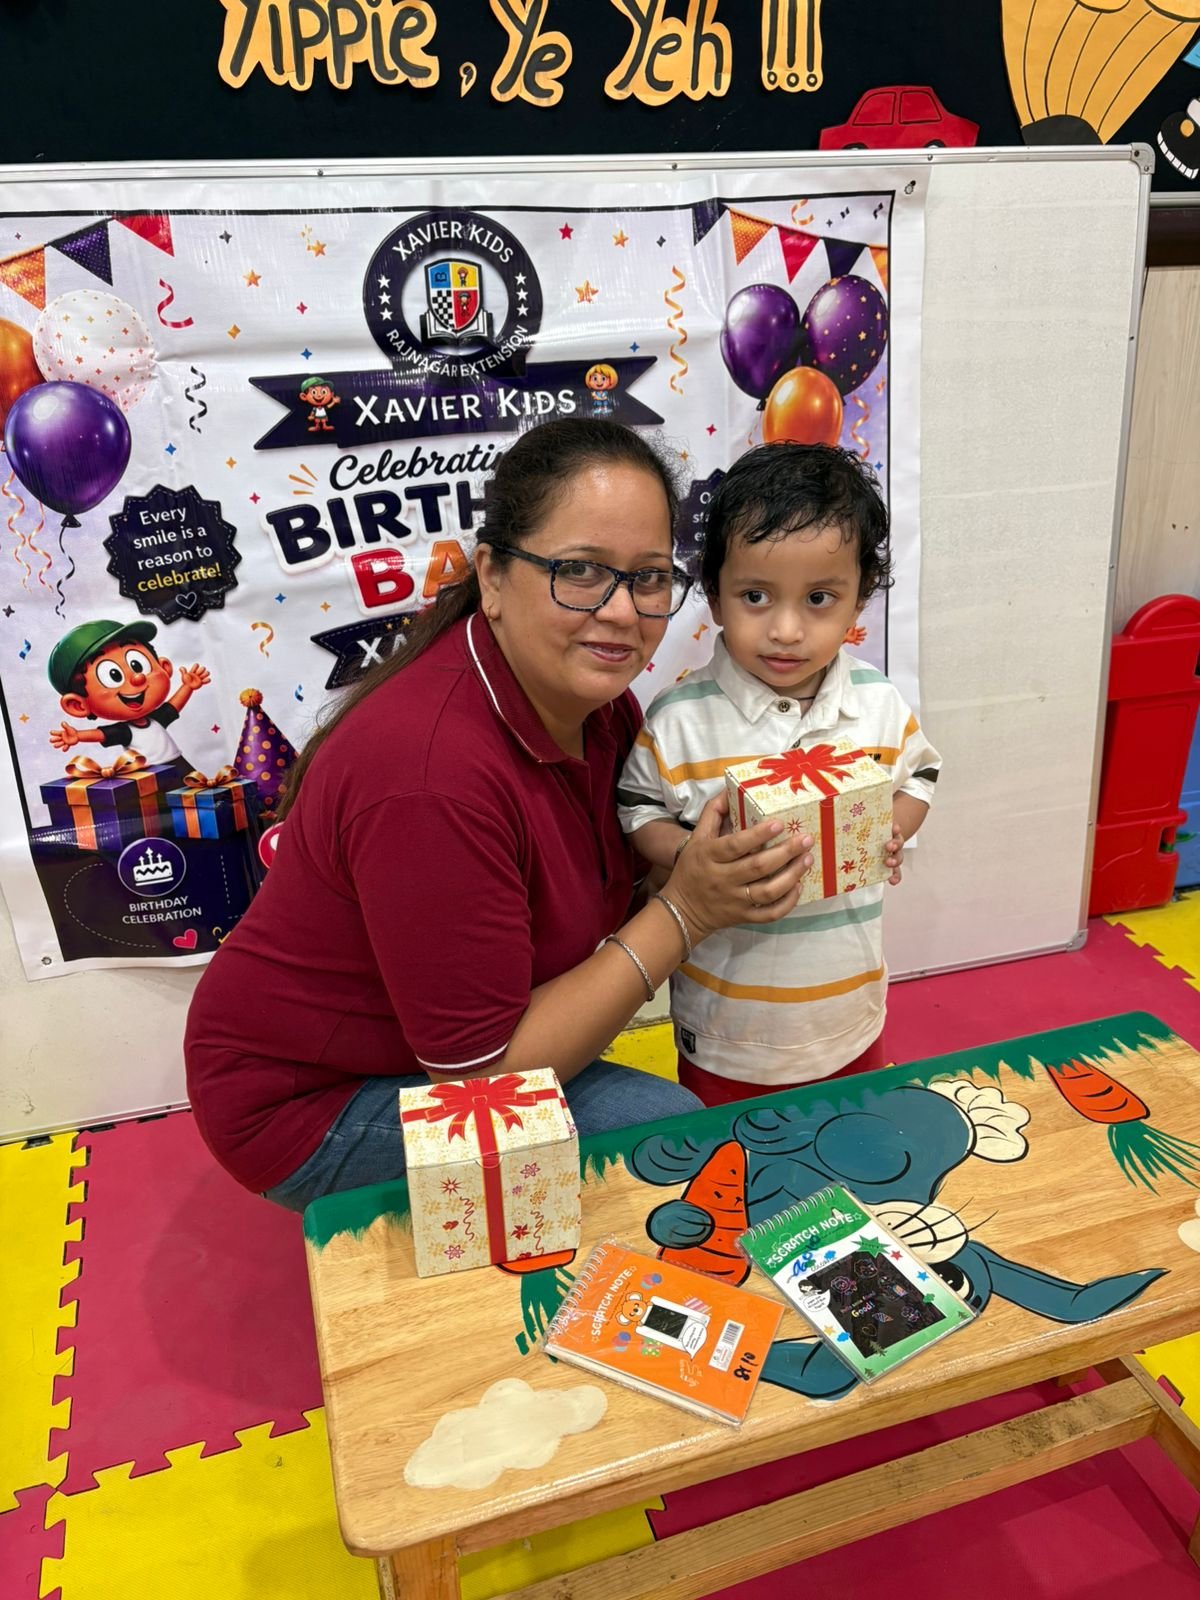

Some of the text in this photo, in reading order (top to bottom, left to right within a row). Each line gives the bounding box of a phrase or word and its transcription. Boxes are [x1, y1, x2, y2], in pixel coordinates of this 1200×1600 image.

[392, 220, 515, 264] XAVIER KIDS
[386, 324, 529, 378] RAJNAGAR EXTENSION
[353, 387, 577, 427] XAVIER KIDS
[329, 443, 502, 492] Celebrati
[139, 506, 187, 526] Every
[266, 479, 492, 566] BIRTH
[133, 525, 208, 550] smile is a
[137, 545, 213, 571] reason to
[137, 562, 222, 592] celebrate!
[122, 906, 202, 924] CELEBRATION
[128, 895, 189, 912] BIRTHDAY
[771, 1225, 820, 1263] SCRATCH
[819, 1213, 854, 1231] NOTE
[591, 1292, 615, 1336] SCRATCH
[609, 1269, 633, 1292] NOTE
